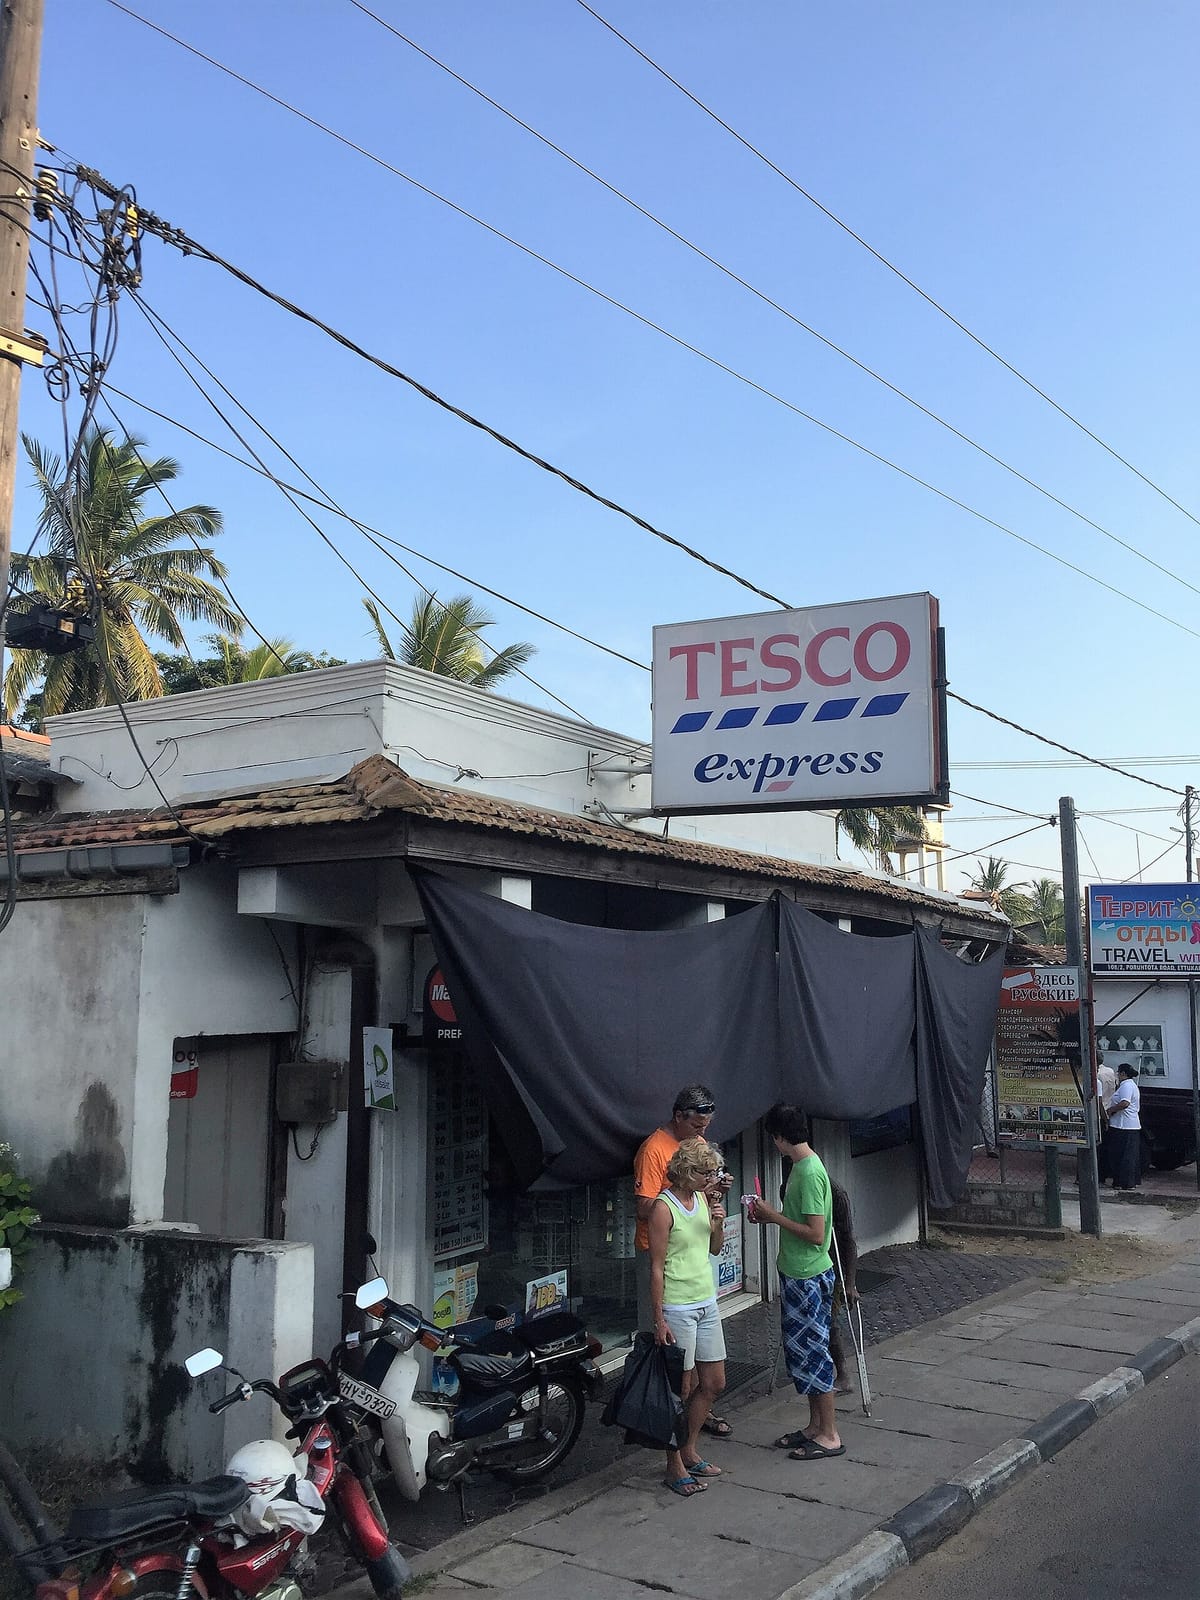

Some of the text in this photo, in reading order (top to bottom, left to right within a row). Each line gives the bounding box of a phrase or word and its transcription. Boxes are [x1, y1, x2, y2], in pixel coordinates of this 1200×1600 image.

[669, 621, 911, 700] TESCO
[694, 751, 884, 793] express
[1102, 948, 1174, 963] TRAVEL
[1034, 975, 1075, 988] ЗДЕСЬ
[1012, 989, 1076, 1001] РУССКИЕ
